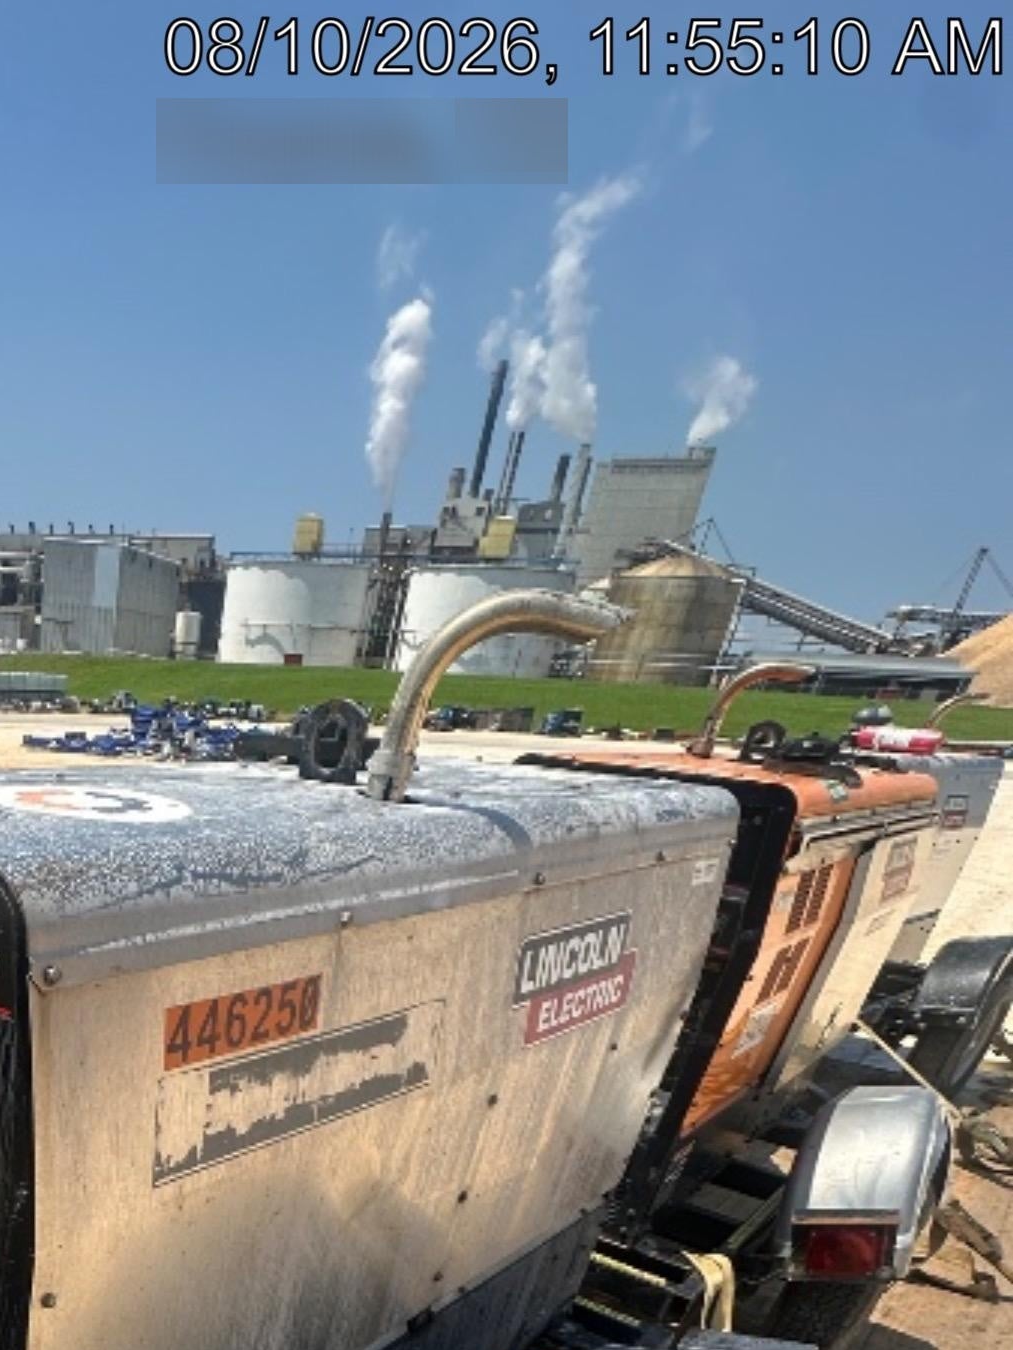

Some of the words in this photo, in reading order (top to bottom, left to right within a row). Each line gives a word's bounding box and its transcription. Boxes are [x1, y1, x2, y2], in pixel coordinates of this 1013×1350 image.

[520, 923, 627, 993] LINCOLN
[167, 973, 322, 1063] 446250
[536, 973, 625, 1033] ELECTRIC
